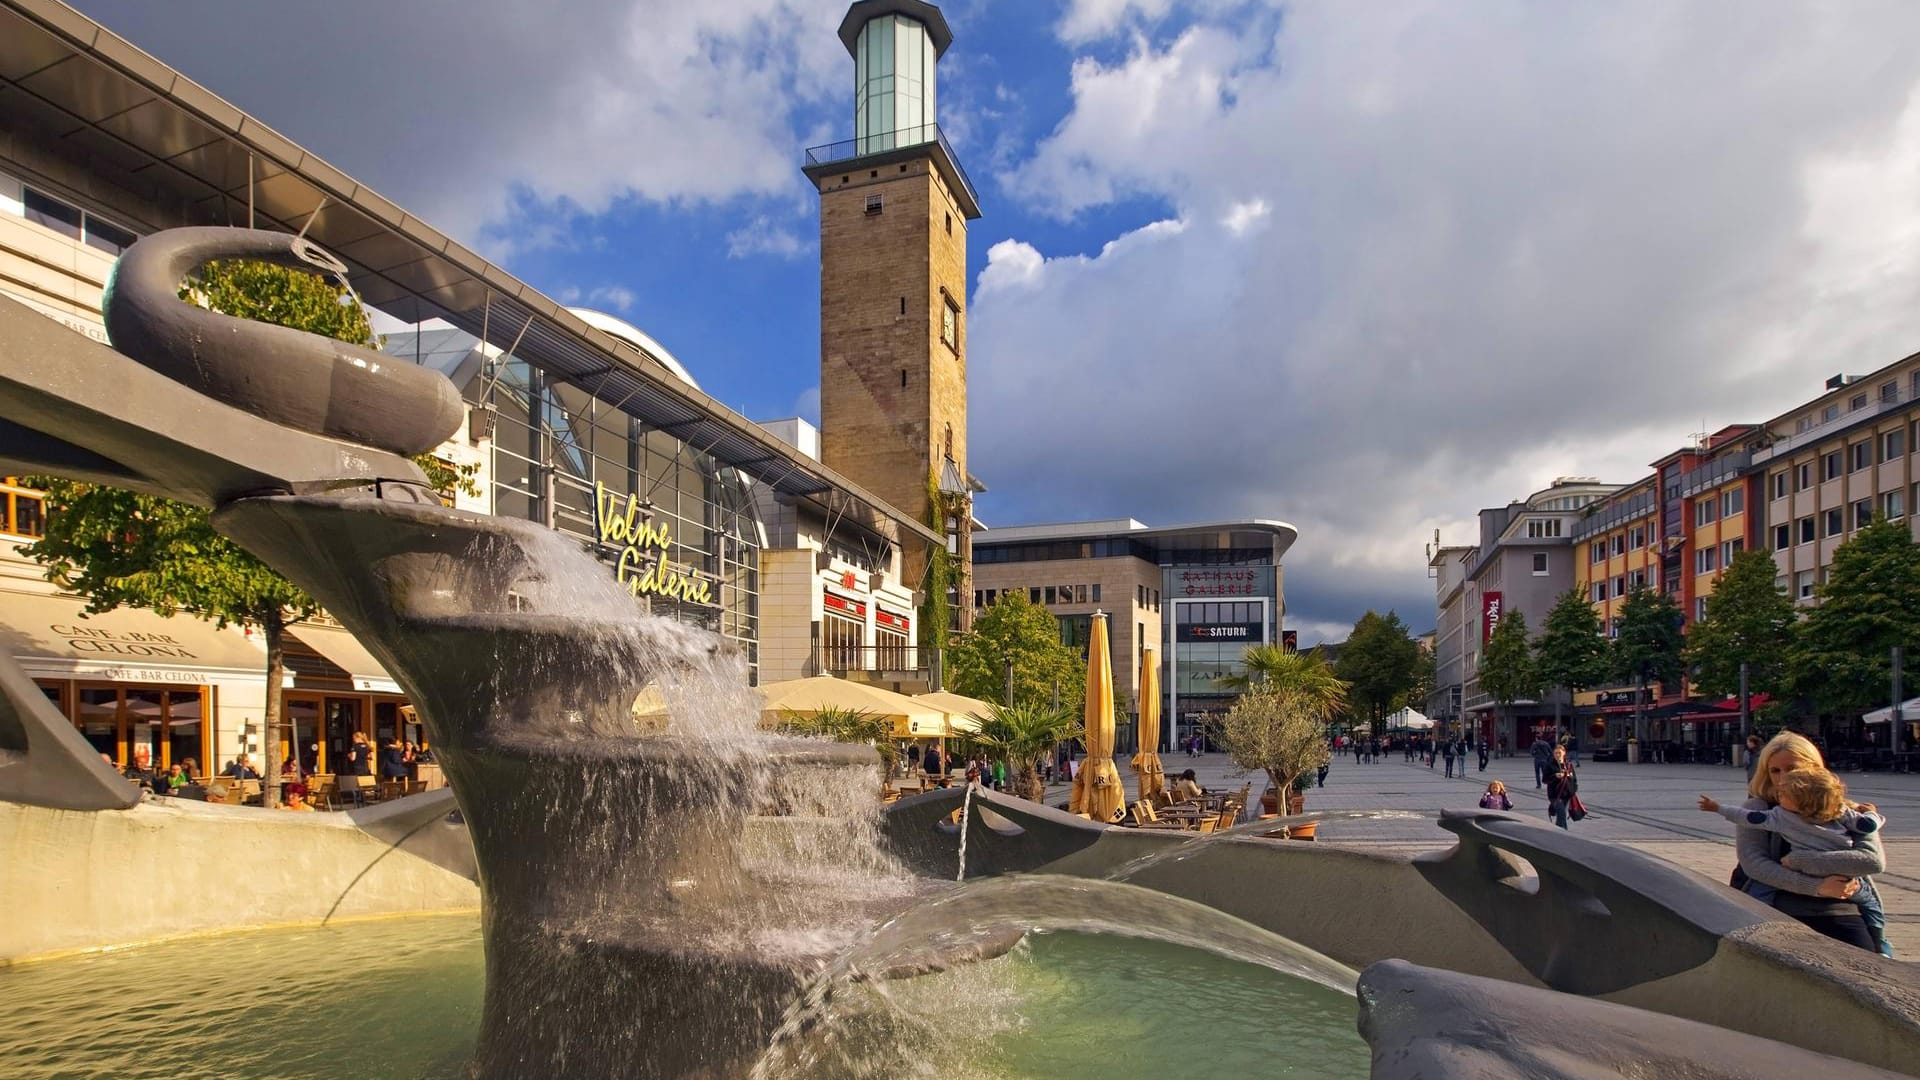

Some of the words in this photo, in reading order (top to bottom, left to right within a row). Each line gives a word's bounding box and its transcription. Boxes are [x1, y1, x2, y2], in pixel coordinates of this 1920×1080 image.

[593, 480, 672, 551] Volme
[615, 545, 713, 604] Galerie
[1183, 569, 1255, 582] RATHAUS
[1185, 583, 1253, 595] GALERIE
[1210, 626, 1247, 637] SATURN
[126, 632, 180, 645] BAR
[68, 639, 199, 659] CELONA
[140, 671, 163, 682] BAR
[164, 672, 207, 683] CELONA
